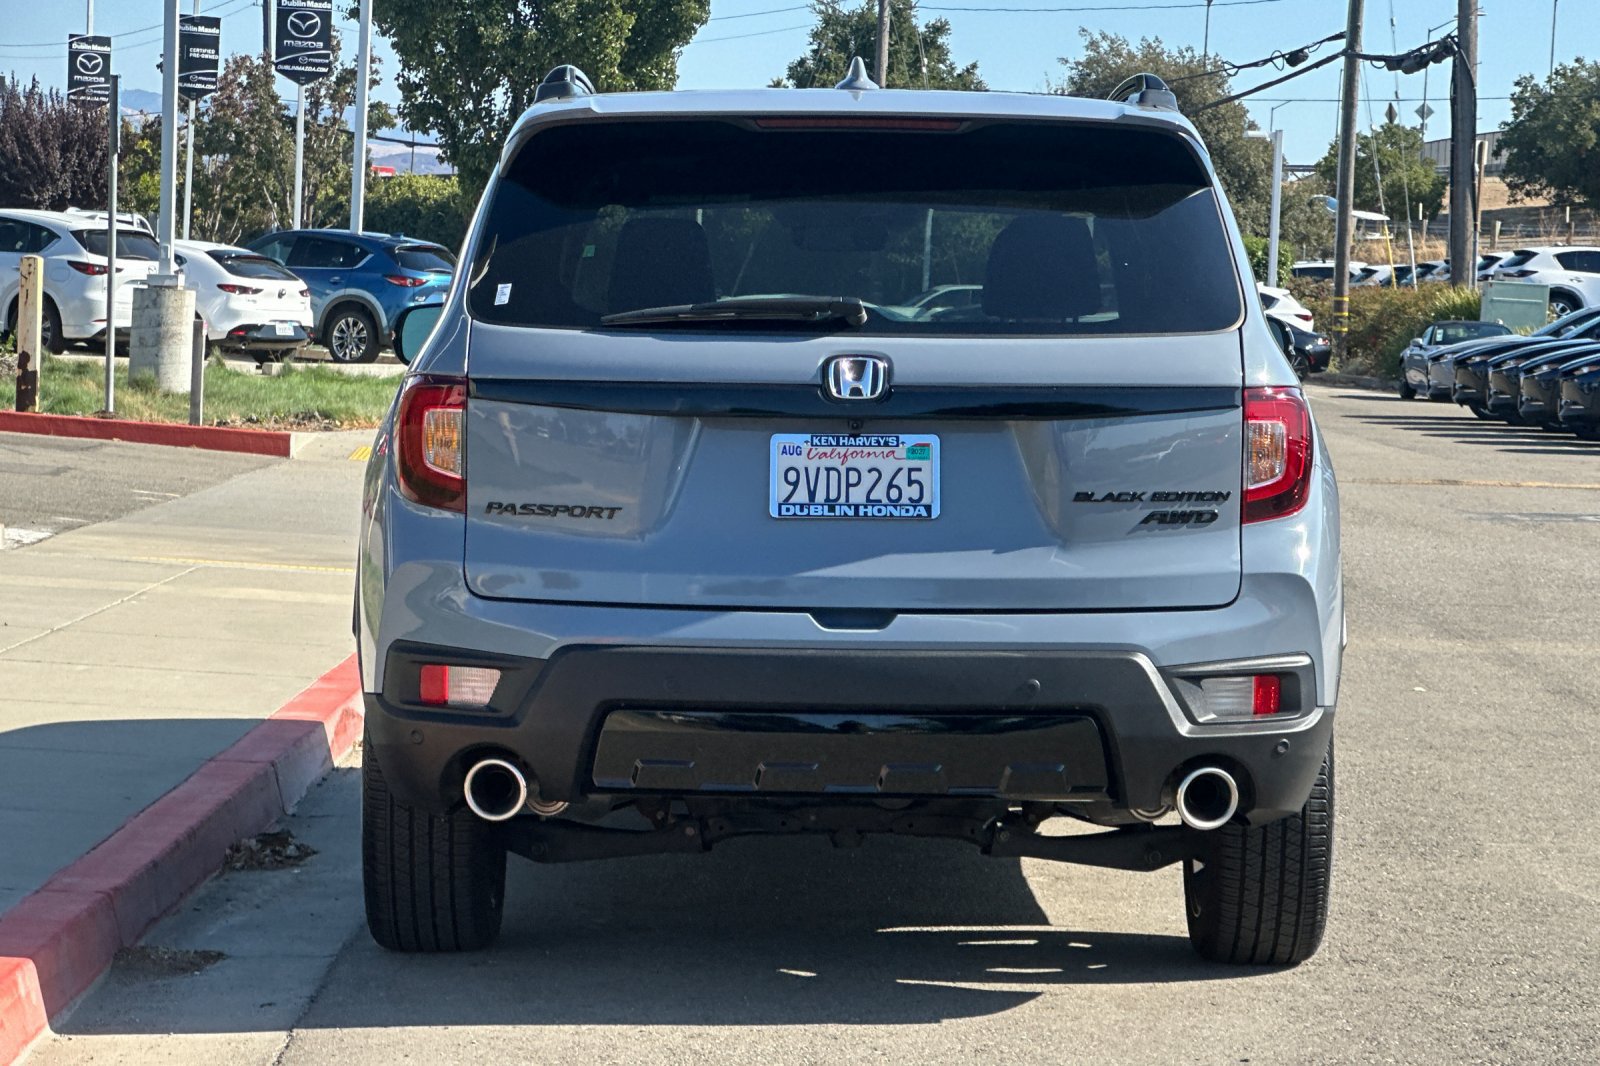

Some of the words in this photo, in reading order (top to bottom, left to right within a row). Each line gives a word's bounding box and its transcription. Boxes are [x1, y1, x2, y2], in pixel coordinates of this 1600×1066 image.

[306, 1, 332, 9] Mazda
[283, 40, 324, 49] mazda
[812, 436, 837, 447] KEN
[839, 436, 898, 447] HARVEY'S
[780, 445, 803, 456] AUG
[807, 448, 905, 466] California
[782, 466, 925, 504] 9VDP265
[1072, 490, 1148, 503] BLACK
[1149, 490, 1233, 503] EDITION
[484, 501, 623, 520] PASSPORT
[780, 504, 855, 517] DUBLIN
[858, 504, 928, 517] HONDA
[1139, 509, 1220, 525] AWD
